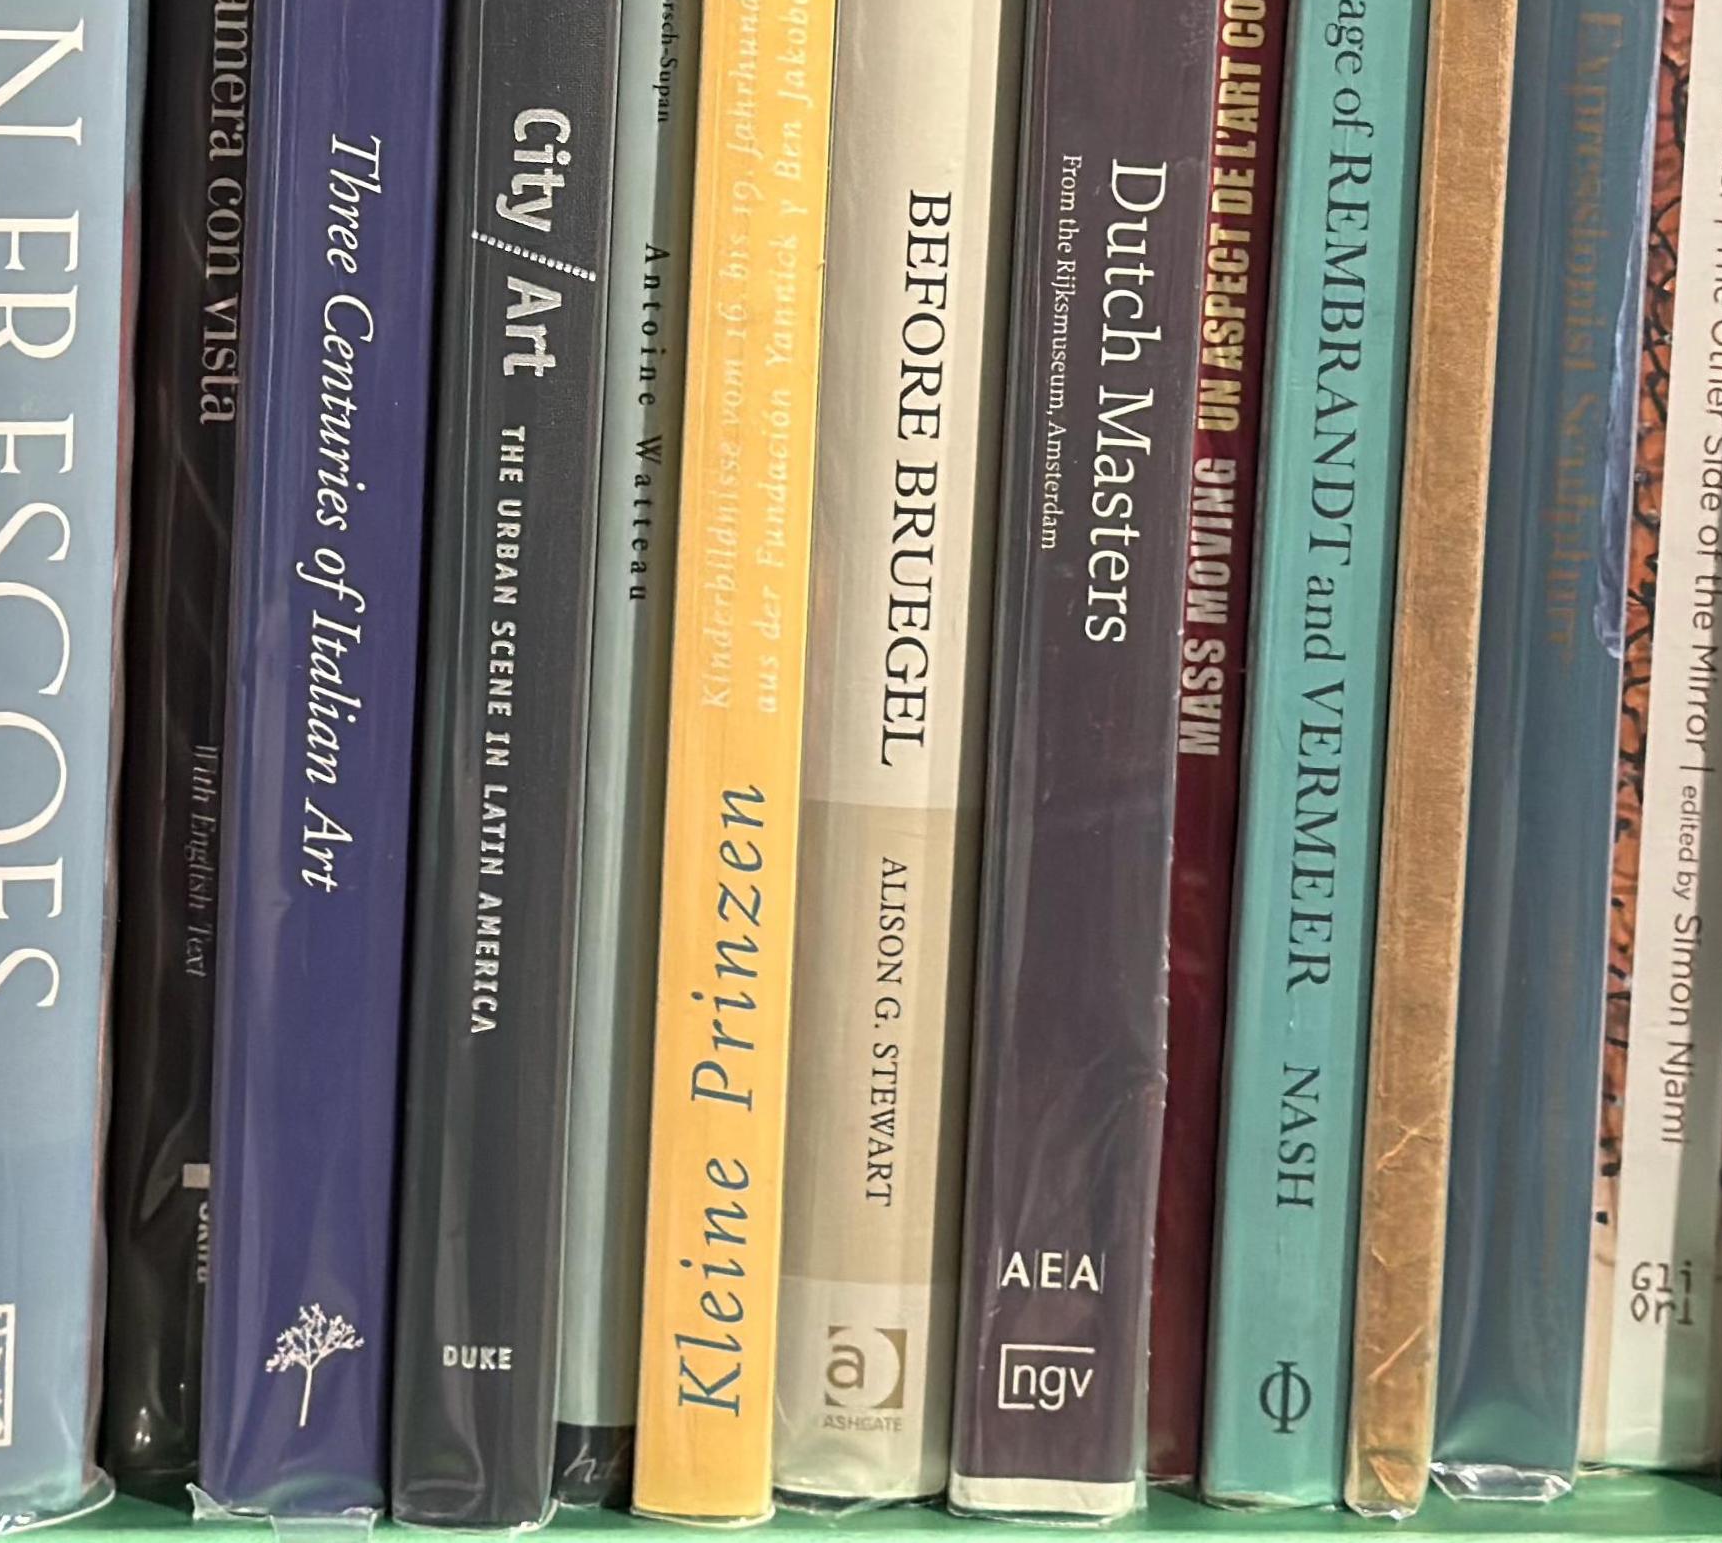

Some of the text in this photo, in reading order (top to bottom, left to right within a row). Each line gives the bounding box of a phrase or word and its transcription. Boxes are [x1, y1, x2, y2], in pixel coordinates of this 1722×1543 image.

[1326, 0, 1366, 75] age
[1214, 56, 1262, 158] L'ART
[1334, 89, 1375, 138] of
[207, 179, 249, 285] con
[497, 110, 572, 378] City Art
[1211, 166, 1255, 215] DE
[201, 299, 242, 423] vista
[1201, 223, 1251, 371] ASPECT
[1308, 153, 1374, 566] REMBRANDT
[630, 244, 670, 602] Antoine Watteau
[1086, 160, 1167, 642] Dutch Masters
[1197, 379, 1242, 432] UN
[296, 135, 382, 893] Three Centuries of Italian Art
[883, 192, 951, 767] BEFORE BRUEGEL
[1186, 458, 1237, 622] MOVING
[1304, 577, 1346, 662] and
[1180, 633, 1222, 757] MASS
[1285, 681, 1347, 993] VERMEER
[867, 858, 908, 1207] ALISON G. STEWART
[675, 785, 767, 1419] Kleine Prinzen
[1275, 1063, 1320, 1211] NASH
[444, 1347, 512, 1370] DUKE
[825, 1413, 905, 1435] ASHGATE
[1012, 1366, 1094, 1411] ngv
